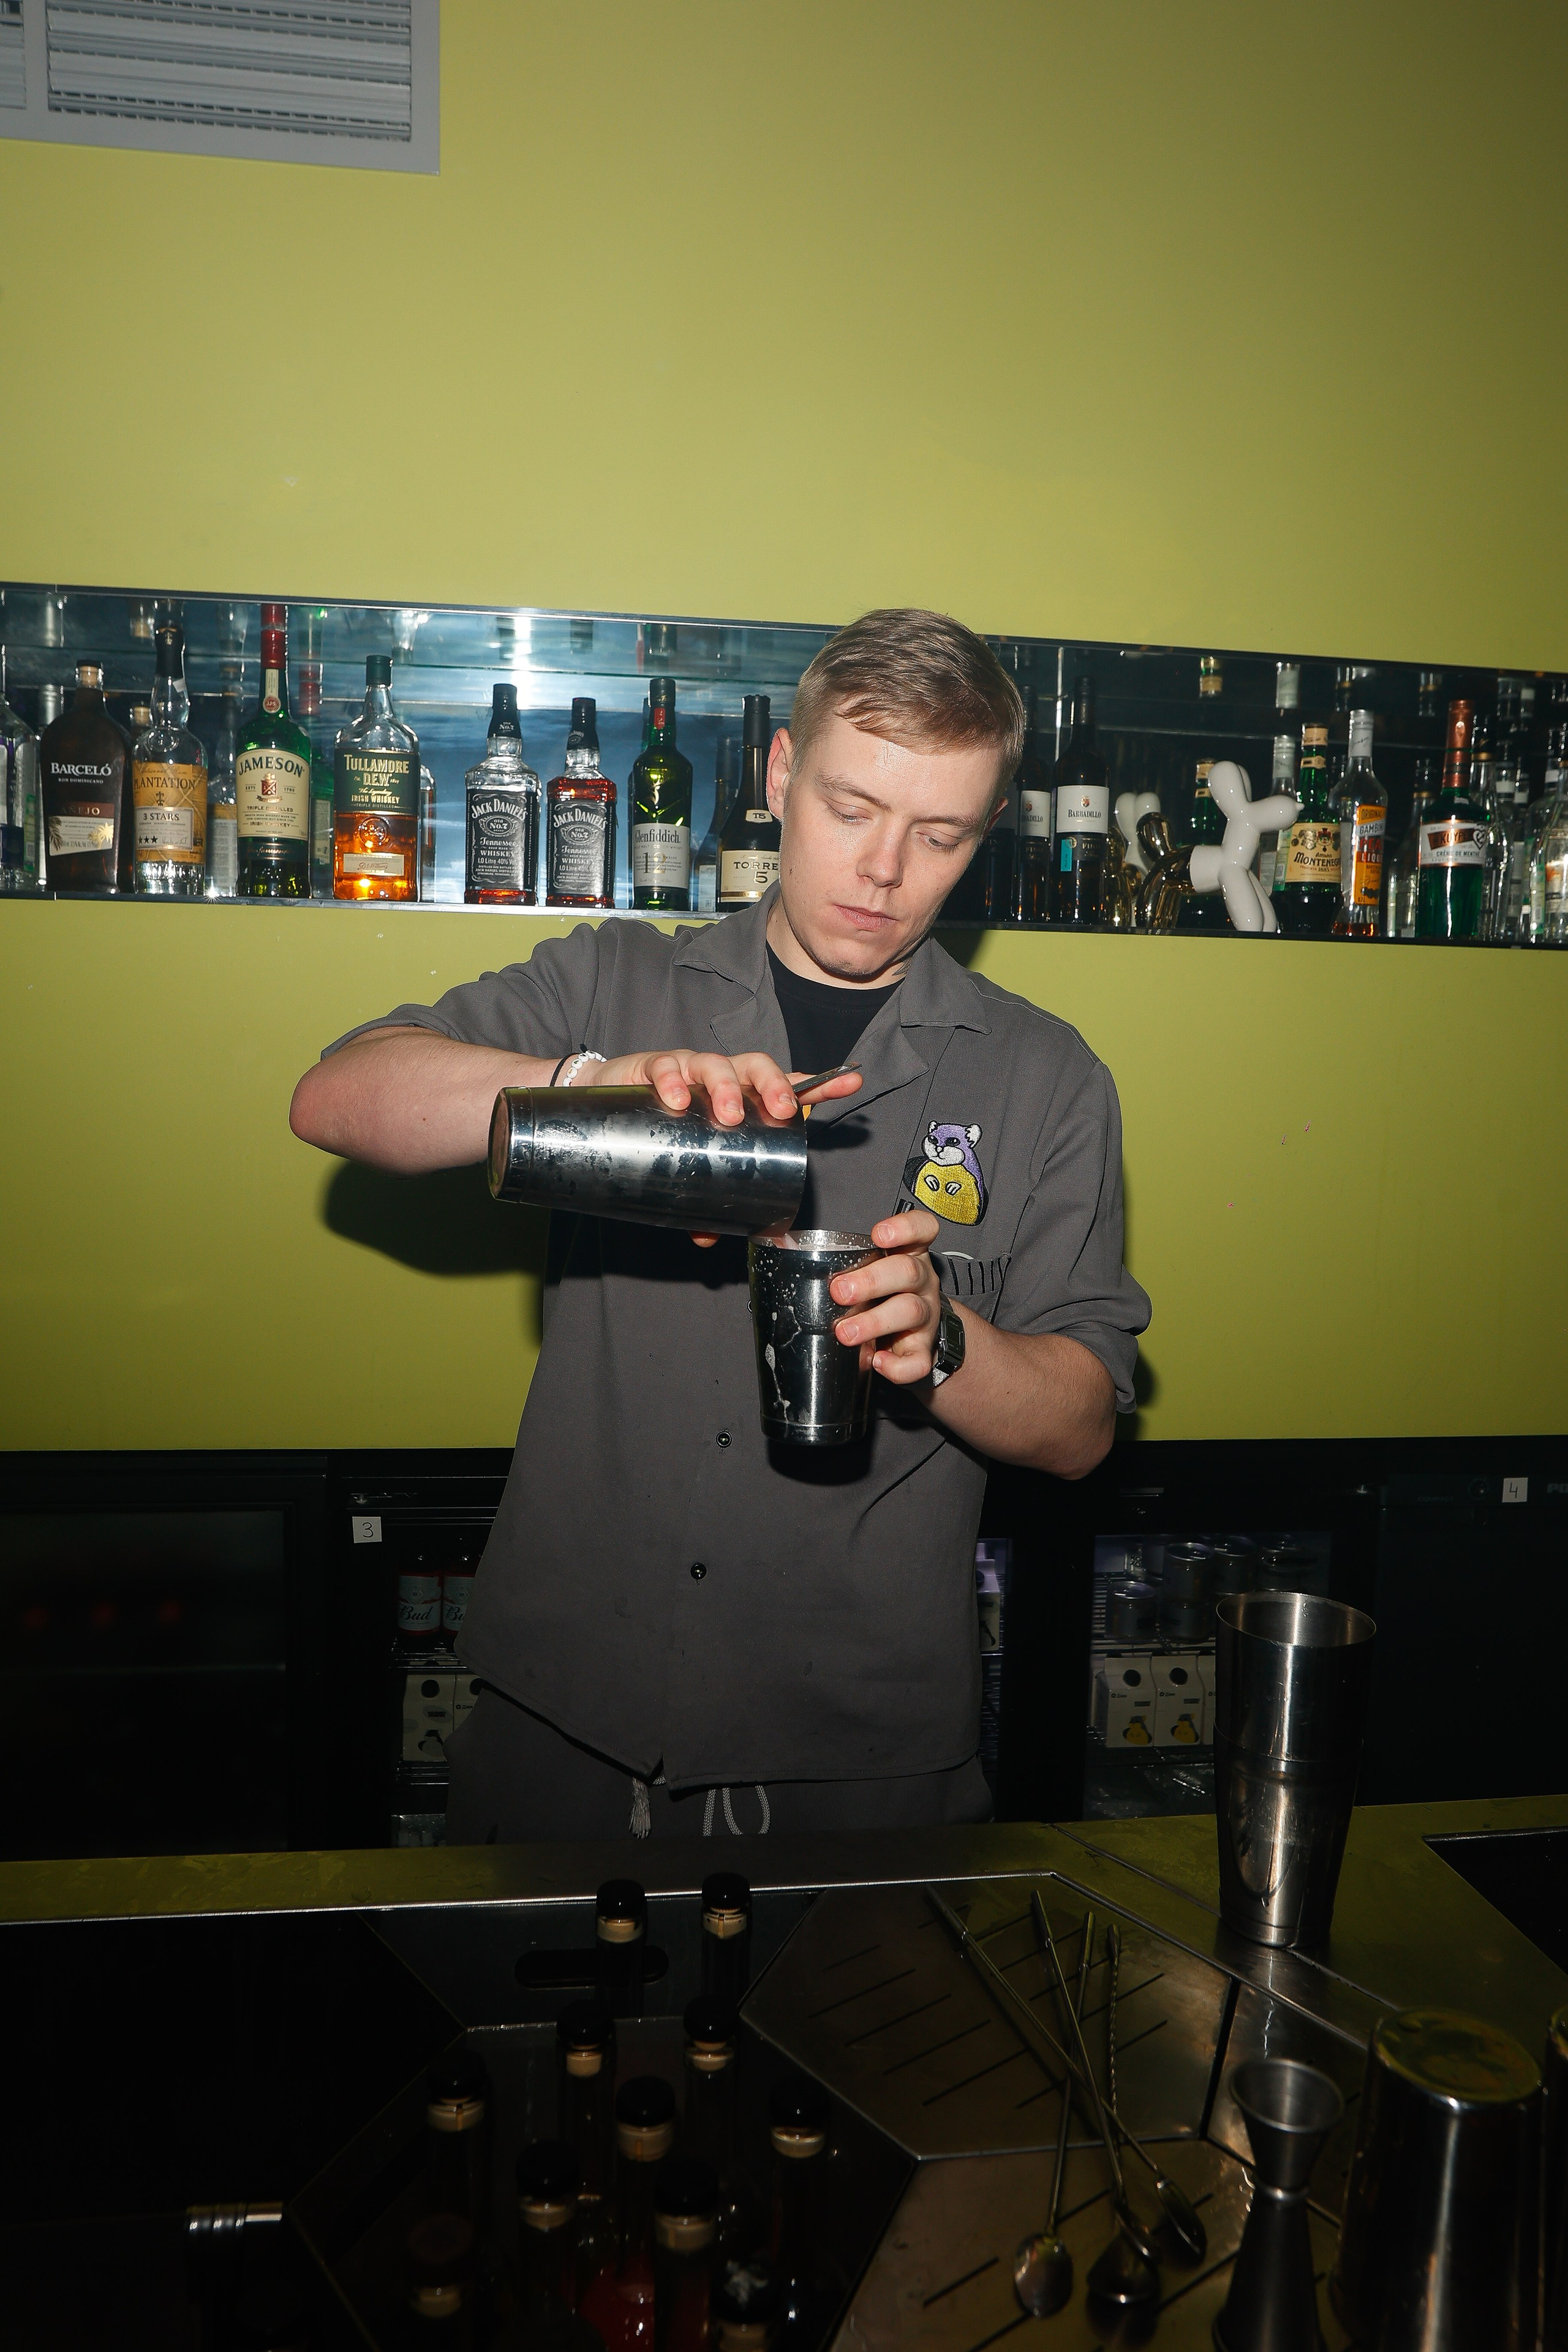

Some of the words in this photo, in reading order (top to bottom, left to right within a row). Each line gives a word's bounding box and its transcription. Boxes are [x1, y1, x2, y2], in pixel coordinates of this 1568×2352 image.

[51, 762, 112, 777] BARCELÓ
[239, 756, 303, 778] JAMESON
[344, 754, 410, 774] TULLAMORE
[134, 777, 195, 790] PLANTATION
[371, 795, 400, 804] WHISKEY
[471, 802, 493, 819] JACK
[493, 798, 528, 821] DANIEL'S
[1068, 809, 1102, 818] BARBADILLO
[553, 811, 575, 827] JACK
[575, 808, 608, 830] DANIEL'S
[635, 829, 680, 843] Glenfiddich
[643, 851, 666, 874] 12
[753, 871, 767, 884] 5
[1509, 1482, 1518, 1499] 4
[362, 1522, 374, 1538] 3
[399, 1604, 433, 1621] Bud
